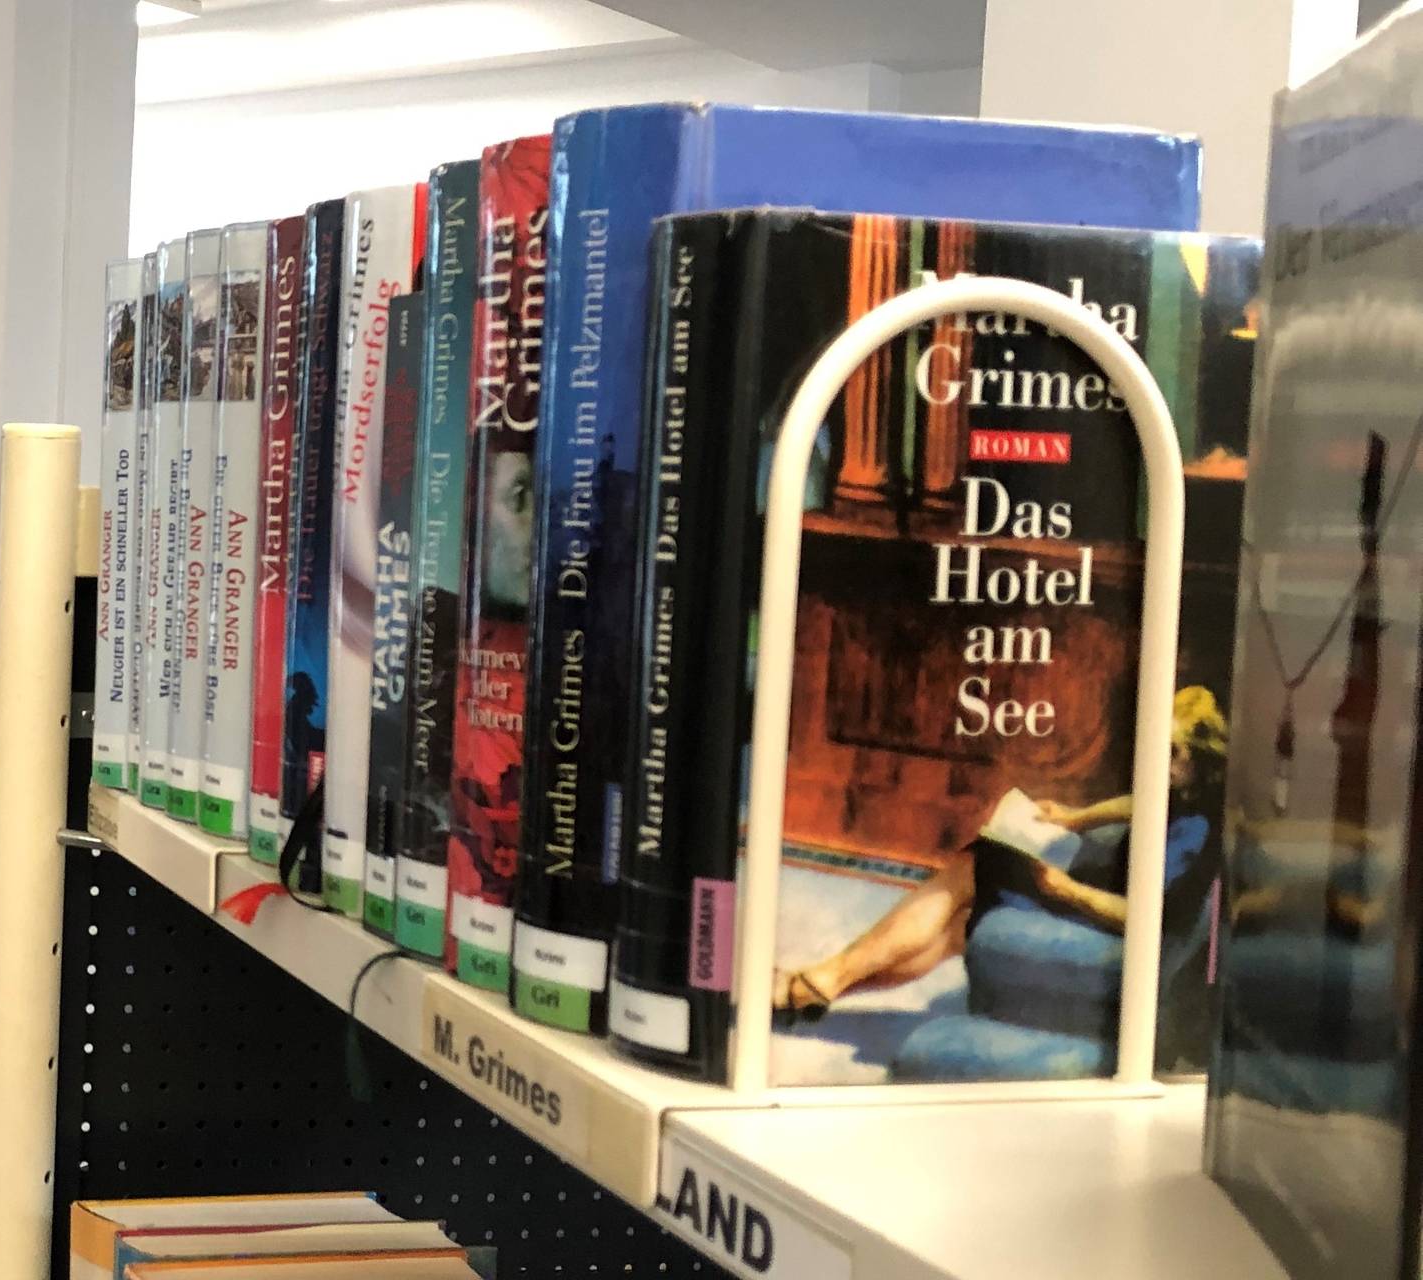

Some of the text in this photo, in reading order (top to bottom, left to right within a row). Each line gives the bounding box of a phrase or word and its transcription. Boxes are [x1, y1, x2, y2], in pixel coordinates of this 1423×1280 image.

[347, 216, 376, 350] Grimes
[439, 196, 468, 306] Martha
[434, 312, 460, 426] Grimes
[476, 214, 515, 432] Martha
[502, 208, 550, 434] Grimes
[915, 343, 1130, 413] Grimes
[260, 254, 298, 594] Martha Grimes
[342, 278, 402, 504] Mordserfolg
[974, 434, 1068, 459] ROMAN
[429, 452, 452, 497] Die
[959, 475, 1073, 540] Das
[97, 510, 113, 642] ANN GRANGER
[110, 448, 130, 703] NEUGIER IST EIN SCHNELLER TOD
[148, 507, 161, 598] GRANGER
[184, 505, 208, 660] ANN GRANGER
[222, 509, 249, 671] ANN GRANGER
[543, 207, 611, 882] Martha Grimes Die Frau im Pelzmantel
[637, 245, 696, 858] Martha Grimes Das Hotel am See
[929, 542, 1095, 606] Hotel
[371, 520, 396, 712] MARTHA
[387, 528, 411, 703] GRIMES
[417, 622, 438, 689] zum
[963, 623, 1054, 666] am
[413, 694, 438, 775] Meer
[472, 677, 512, 701] der
[955, 676, 1056, 738] See
[695, 886, 718, 982] GOLDMANN
[531, 984, 561, 1009] Gri
[431, 1013, 564, 1128] M. Grimes
